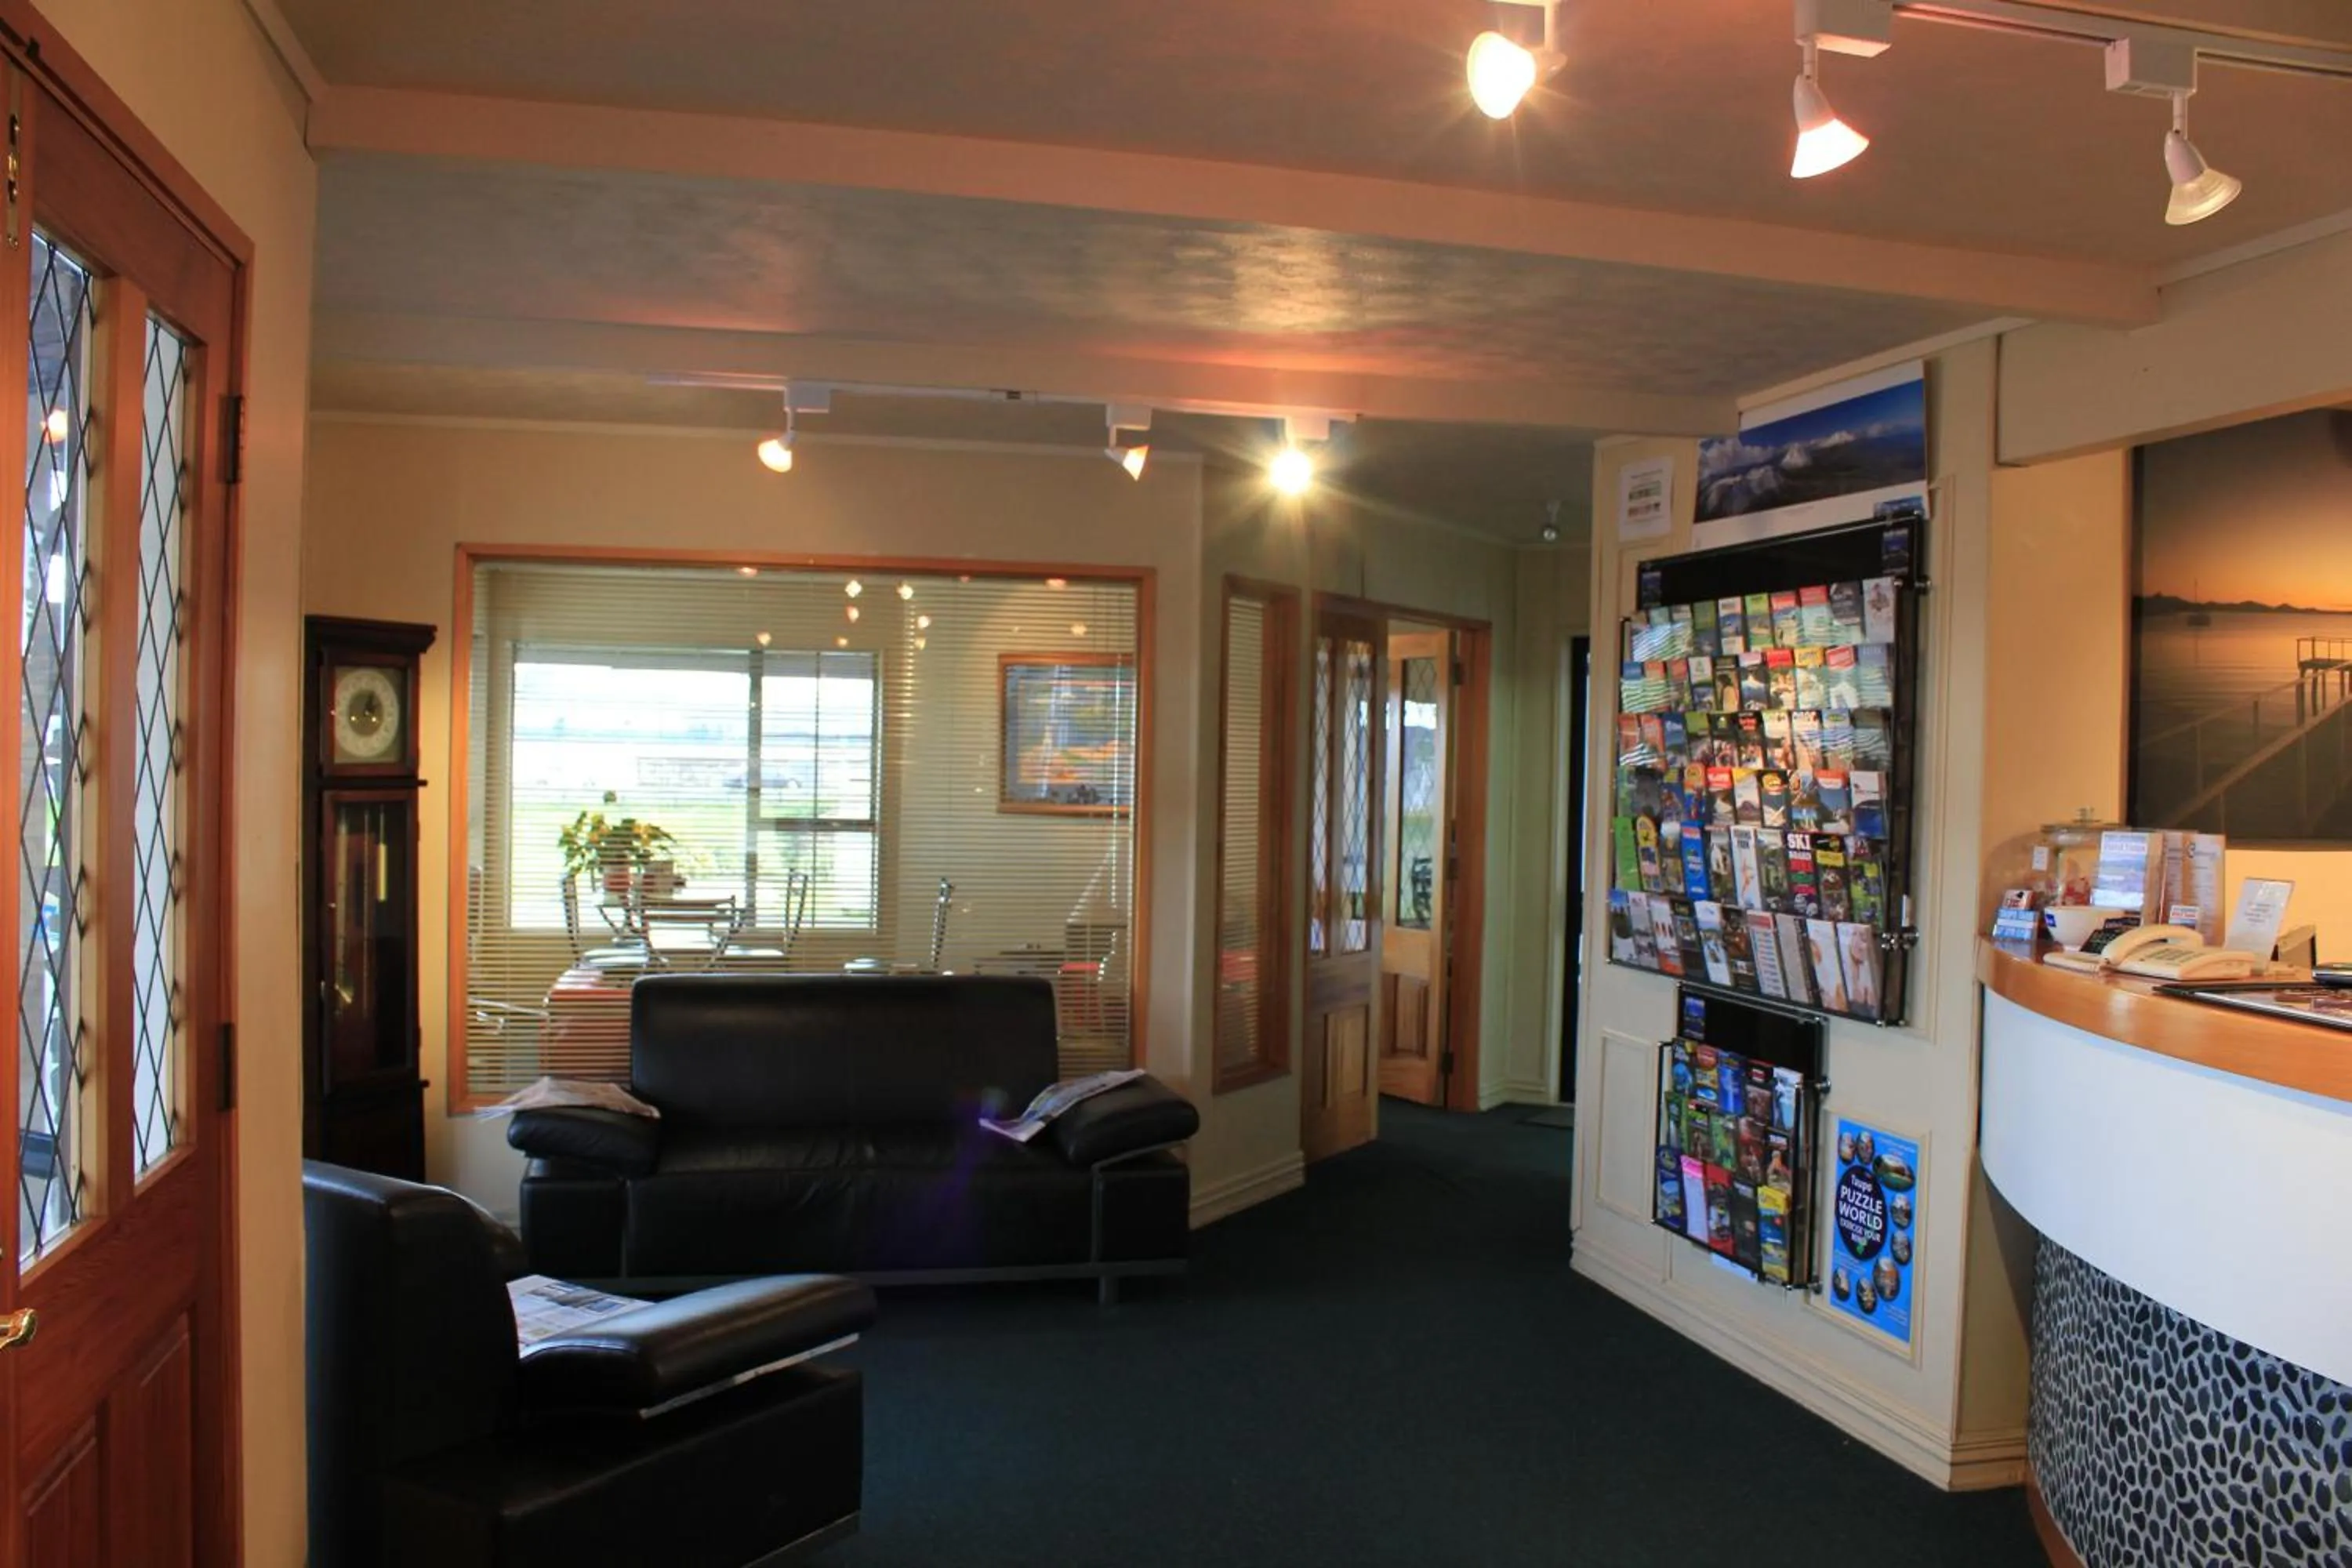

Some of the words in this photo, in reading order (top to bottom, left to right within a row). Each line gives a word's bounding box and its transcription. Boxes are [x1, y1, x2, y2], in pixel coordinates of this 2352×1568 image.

[1787, 833, 1811, 850] SKI
[1840, 1185, 1882, 1215] PUZZLE
[1838, 1200, 1882, 1231] WORLD
